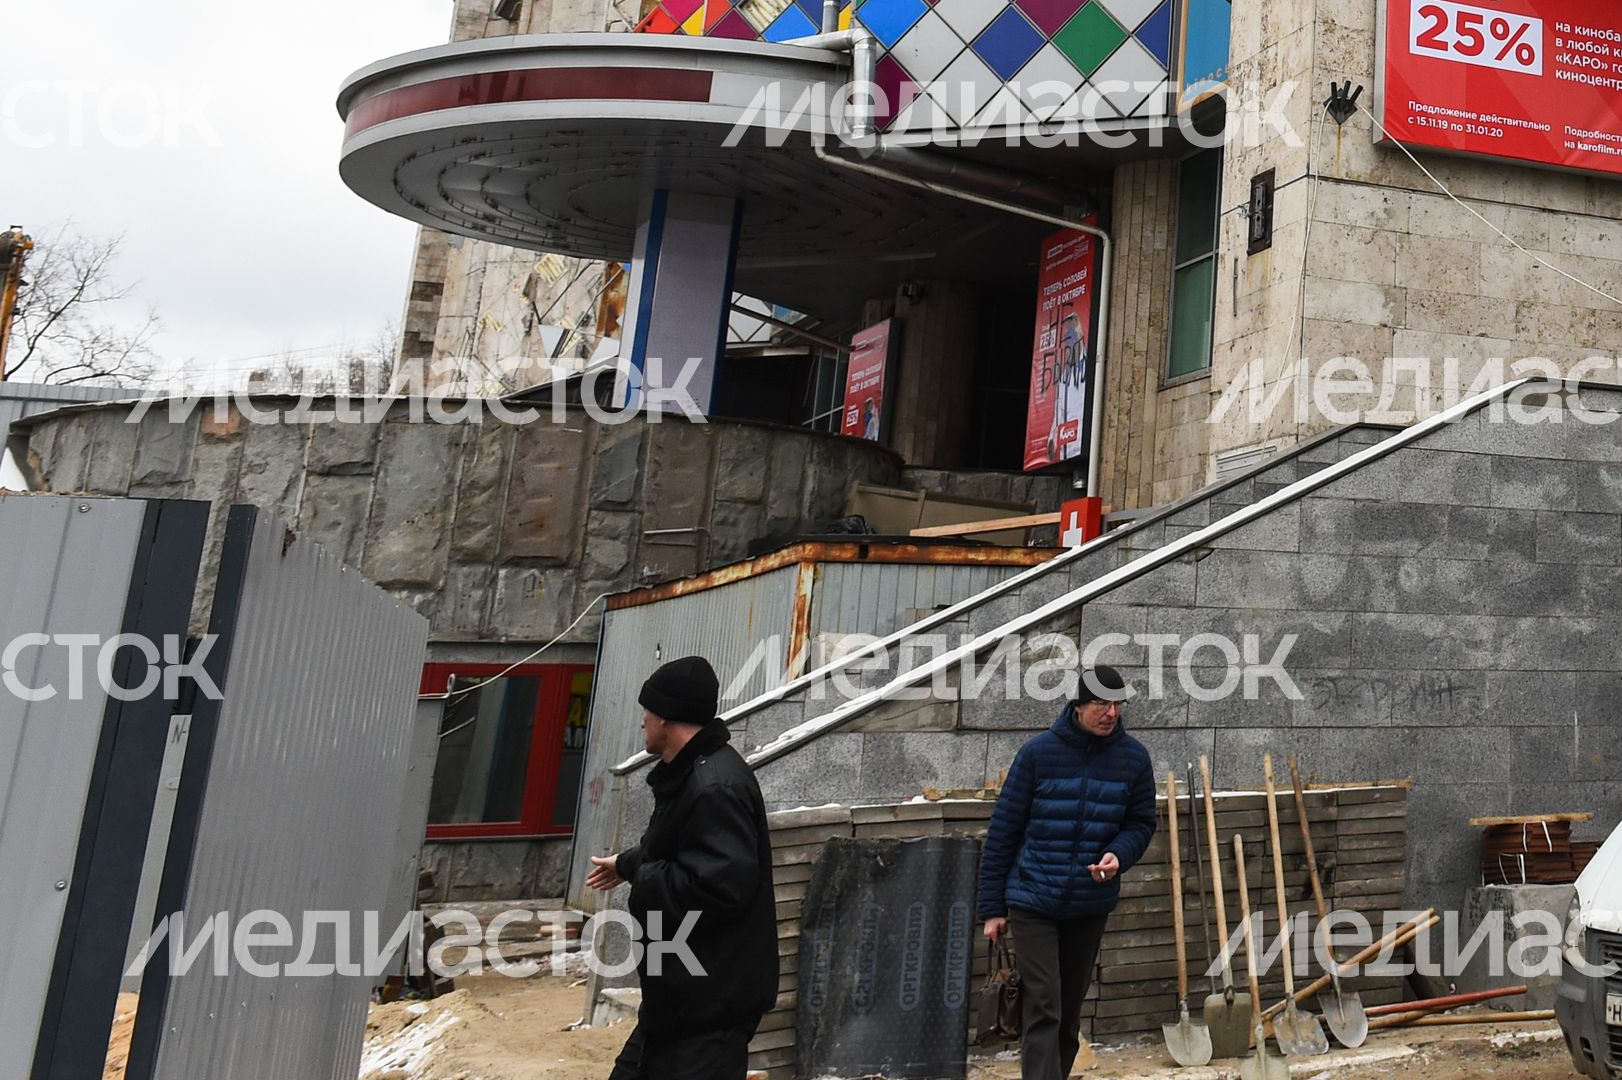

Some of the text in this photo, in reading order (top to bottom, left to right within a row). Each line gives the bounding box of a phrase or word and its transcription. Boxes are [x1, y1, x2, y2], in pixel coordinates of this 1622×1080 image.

[1416, 4, 1536, 66] 25%
[1555, 22, 1571, 33] на
[1555, 37, 1563, 47] в
[1567, 39, 1609, 56] любой
[1555, 52, 1608, 71] «КАРО»
[1407, 116, 1504, 138] с 15.11.19 по 31.01.20
[1408, 100, 1551, 132] Предложение действительно
[1564, 140, 1575, 149] на
[902, 906, 924, 1006] ОРГКРОВЛЯ
[947, 906, 967, 1004] ОРГКРОВЛЯ
